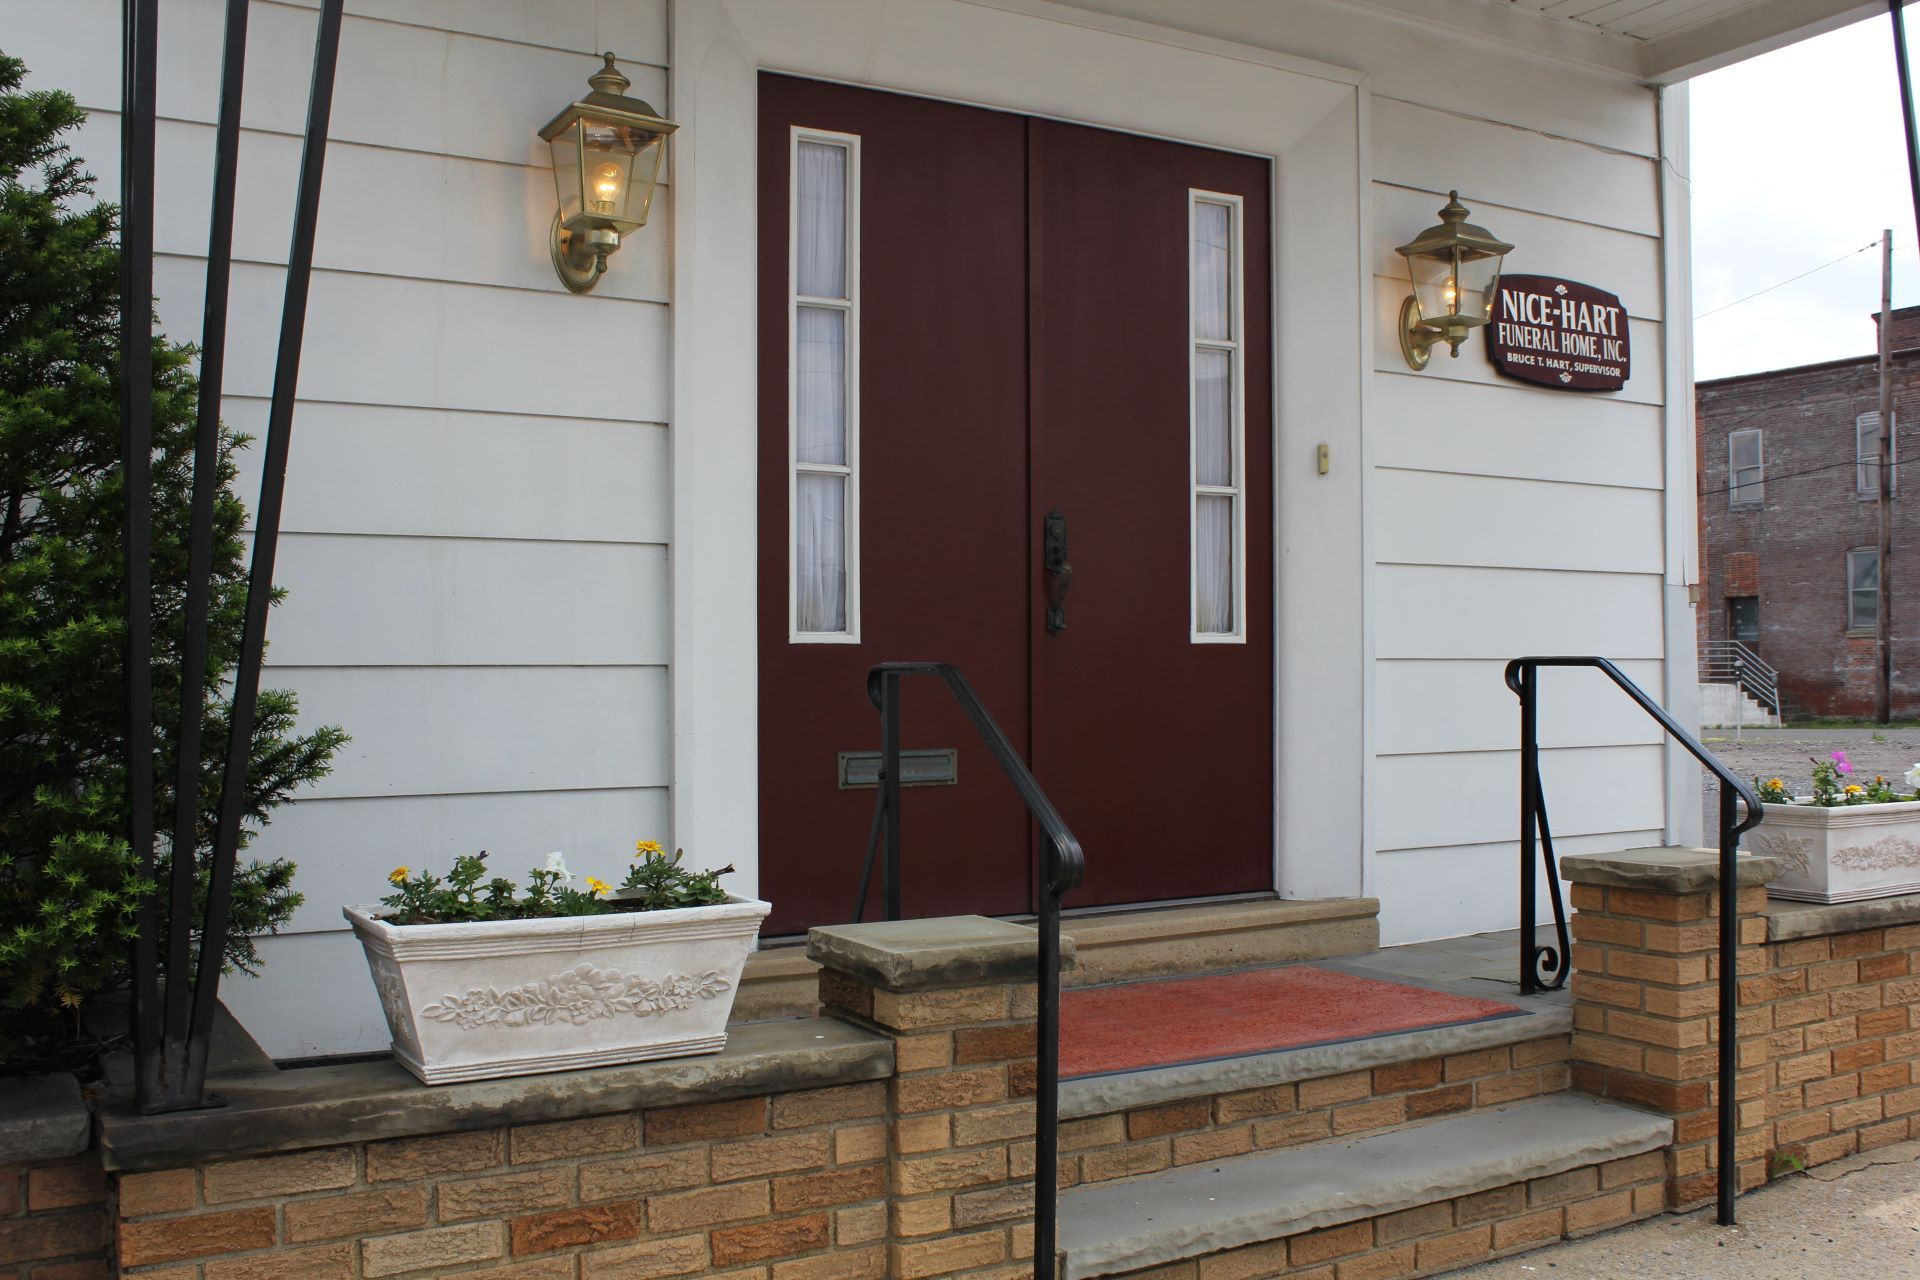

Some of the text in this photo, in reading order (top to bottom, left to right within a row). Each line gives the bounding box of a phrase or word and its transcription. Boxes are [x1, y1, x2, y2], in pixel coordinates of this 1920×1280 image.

[1502, 289, 1619, 336] NICE-HART
[1498, 322, 1627, 363] FUNERAL HOME, INC.
[1507, 352, 1621, 377] BRUCE T. HART, SUPERVISOR
